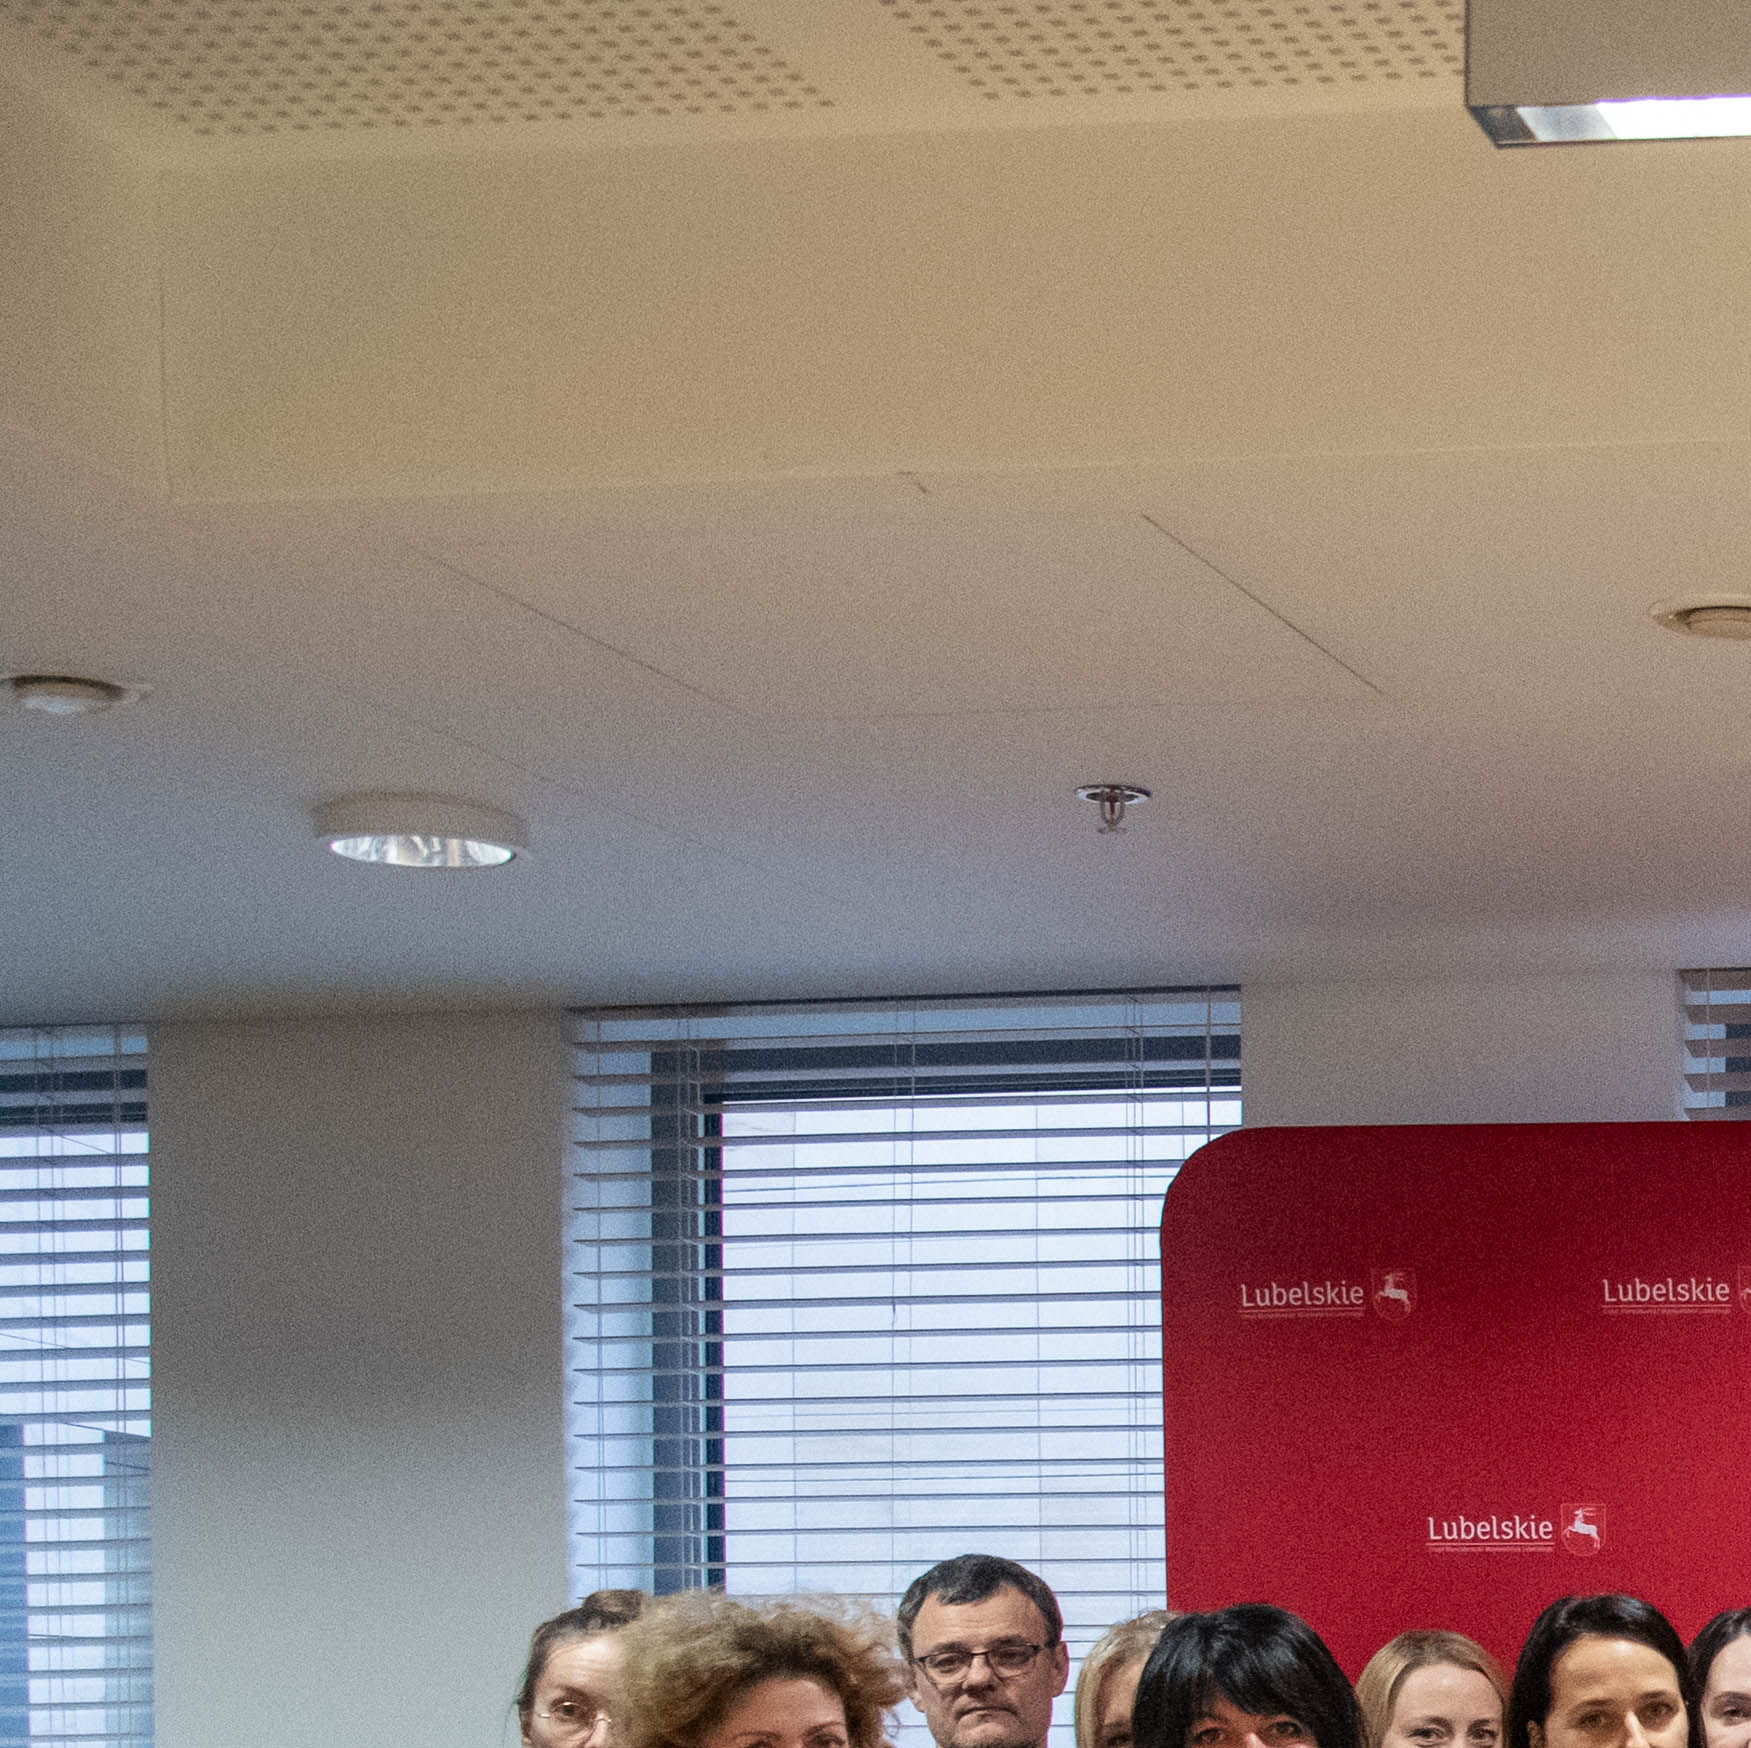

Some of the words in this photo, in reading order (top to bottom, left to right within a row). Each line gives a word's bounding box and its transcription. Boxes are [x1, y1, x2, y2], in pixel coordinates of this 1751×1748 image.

[1240, 1281, 1364, 1308] Lubelskie
[1602, 1277, 1730, 1304] Lubelskie
[1427, 1515, 1553, 1541] Lubelskie
